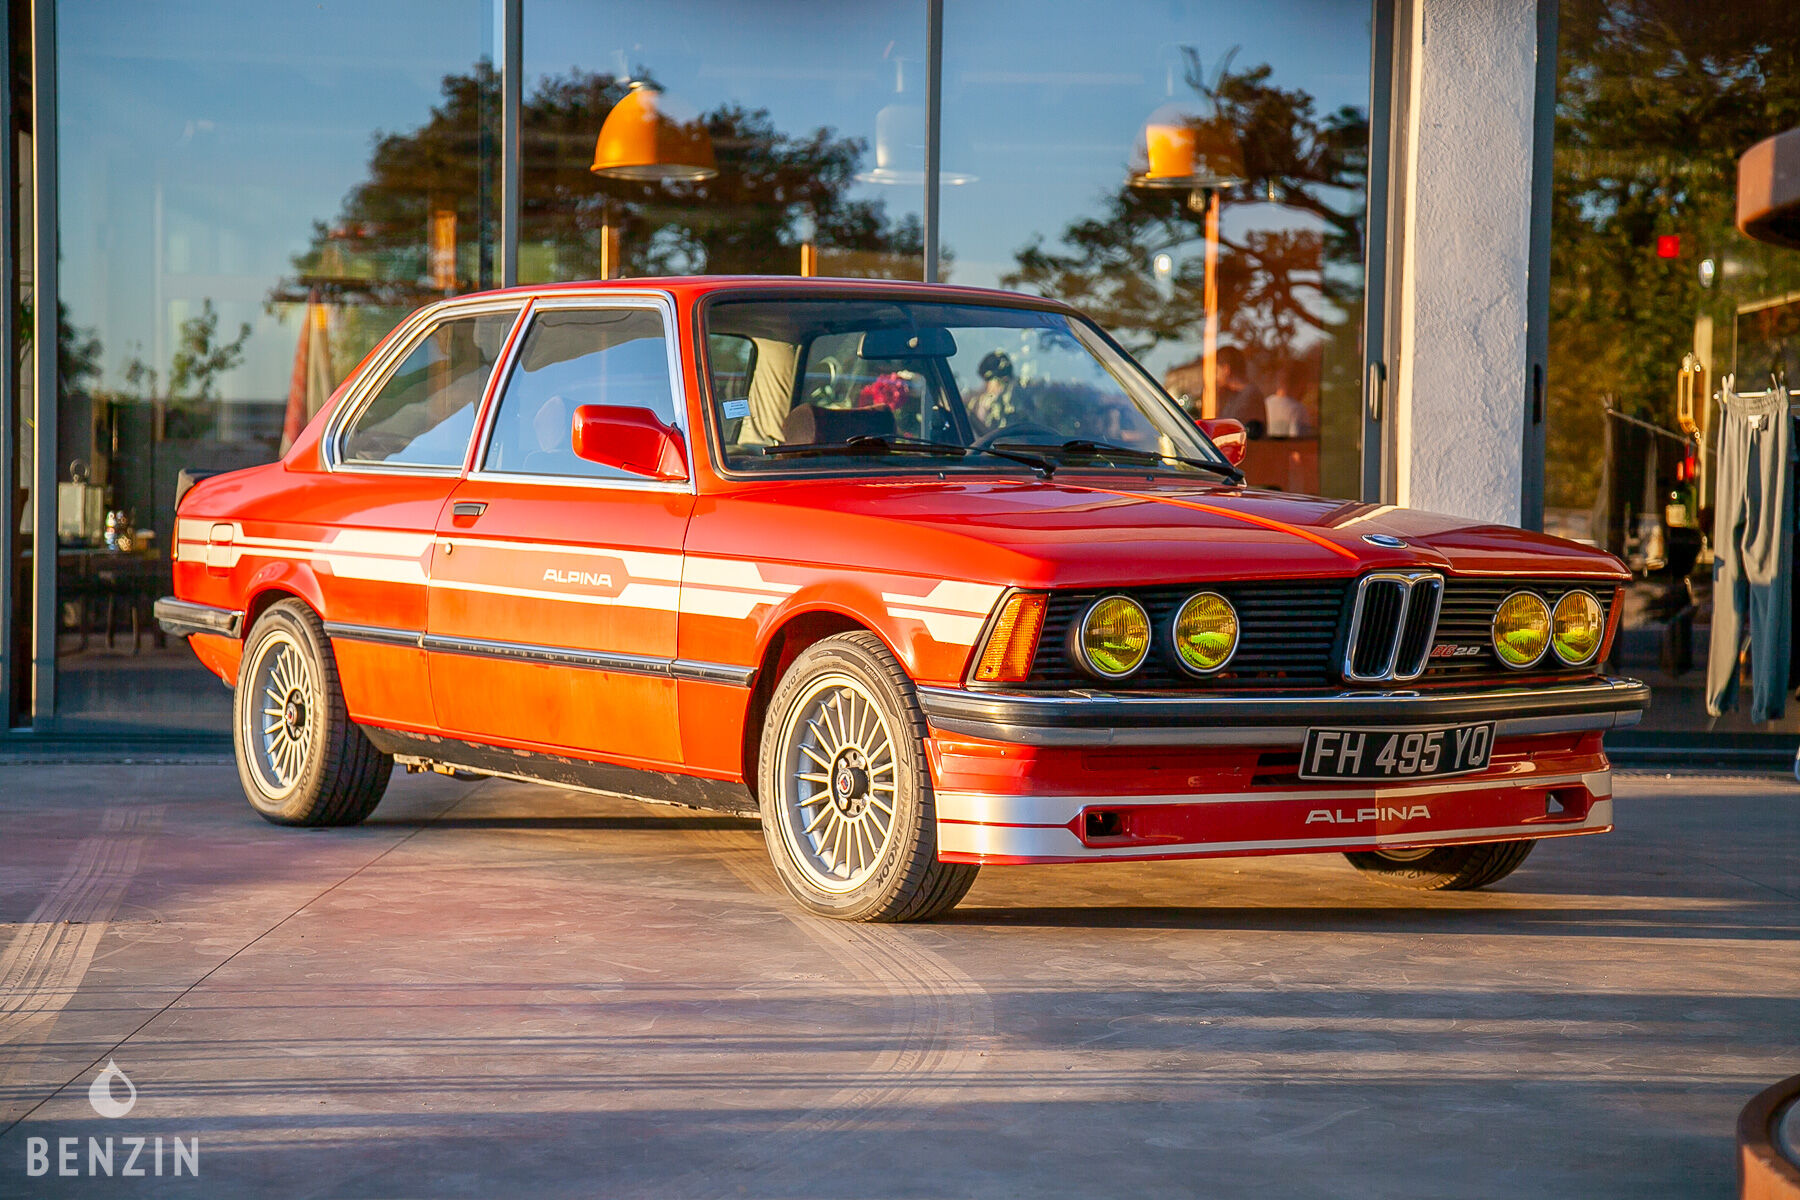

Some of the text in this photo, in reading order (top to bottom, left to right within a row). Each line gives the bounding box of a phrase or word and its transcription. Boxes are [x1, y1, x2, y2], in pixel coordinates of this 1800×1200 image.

[543, 568, 612, 588] ALPINA
[768, 696, 782, 729] V12
[1311, 726, 1489, 774] FH 495 YQ
[1305, 805, 1431, 824] ALPINA
